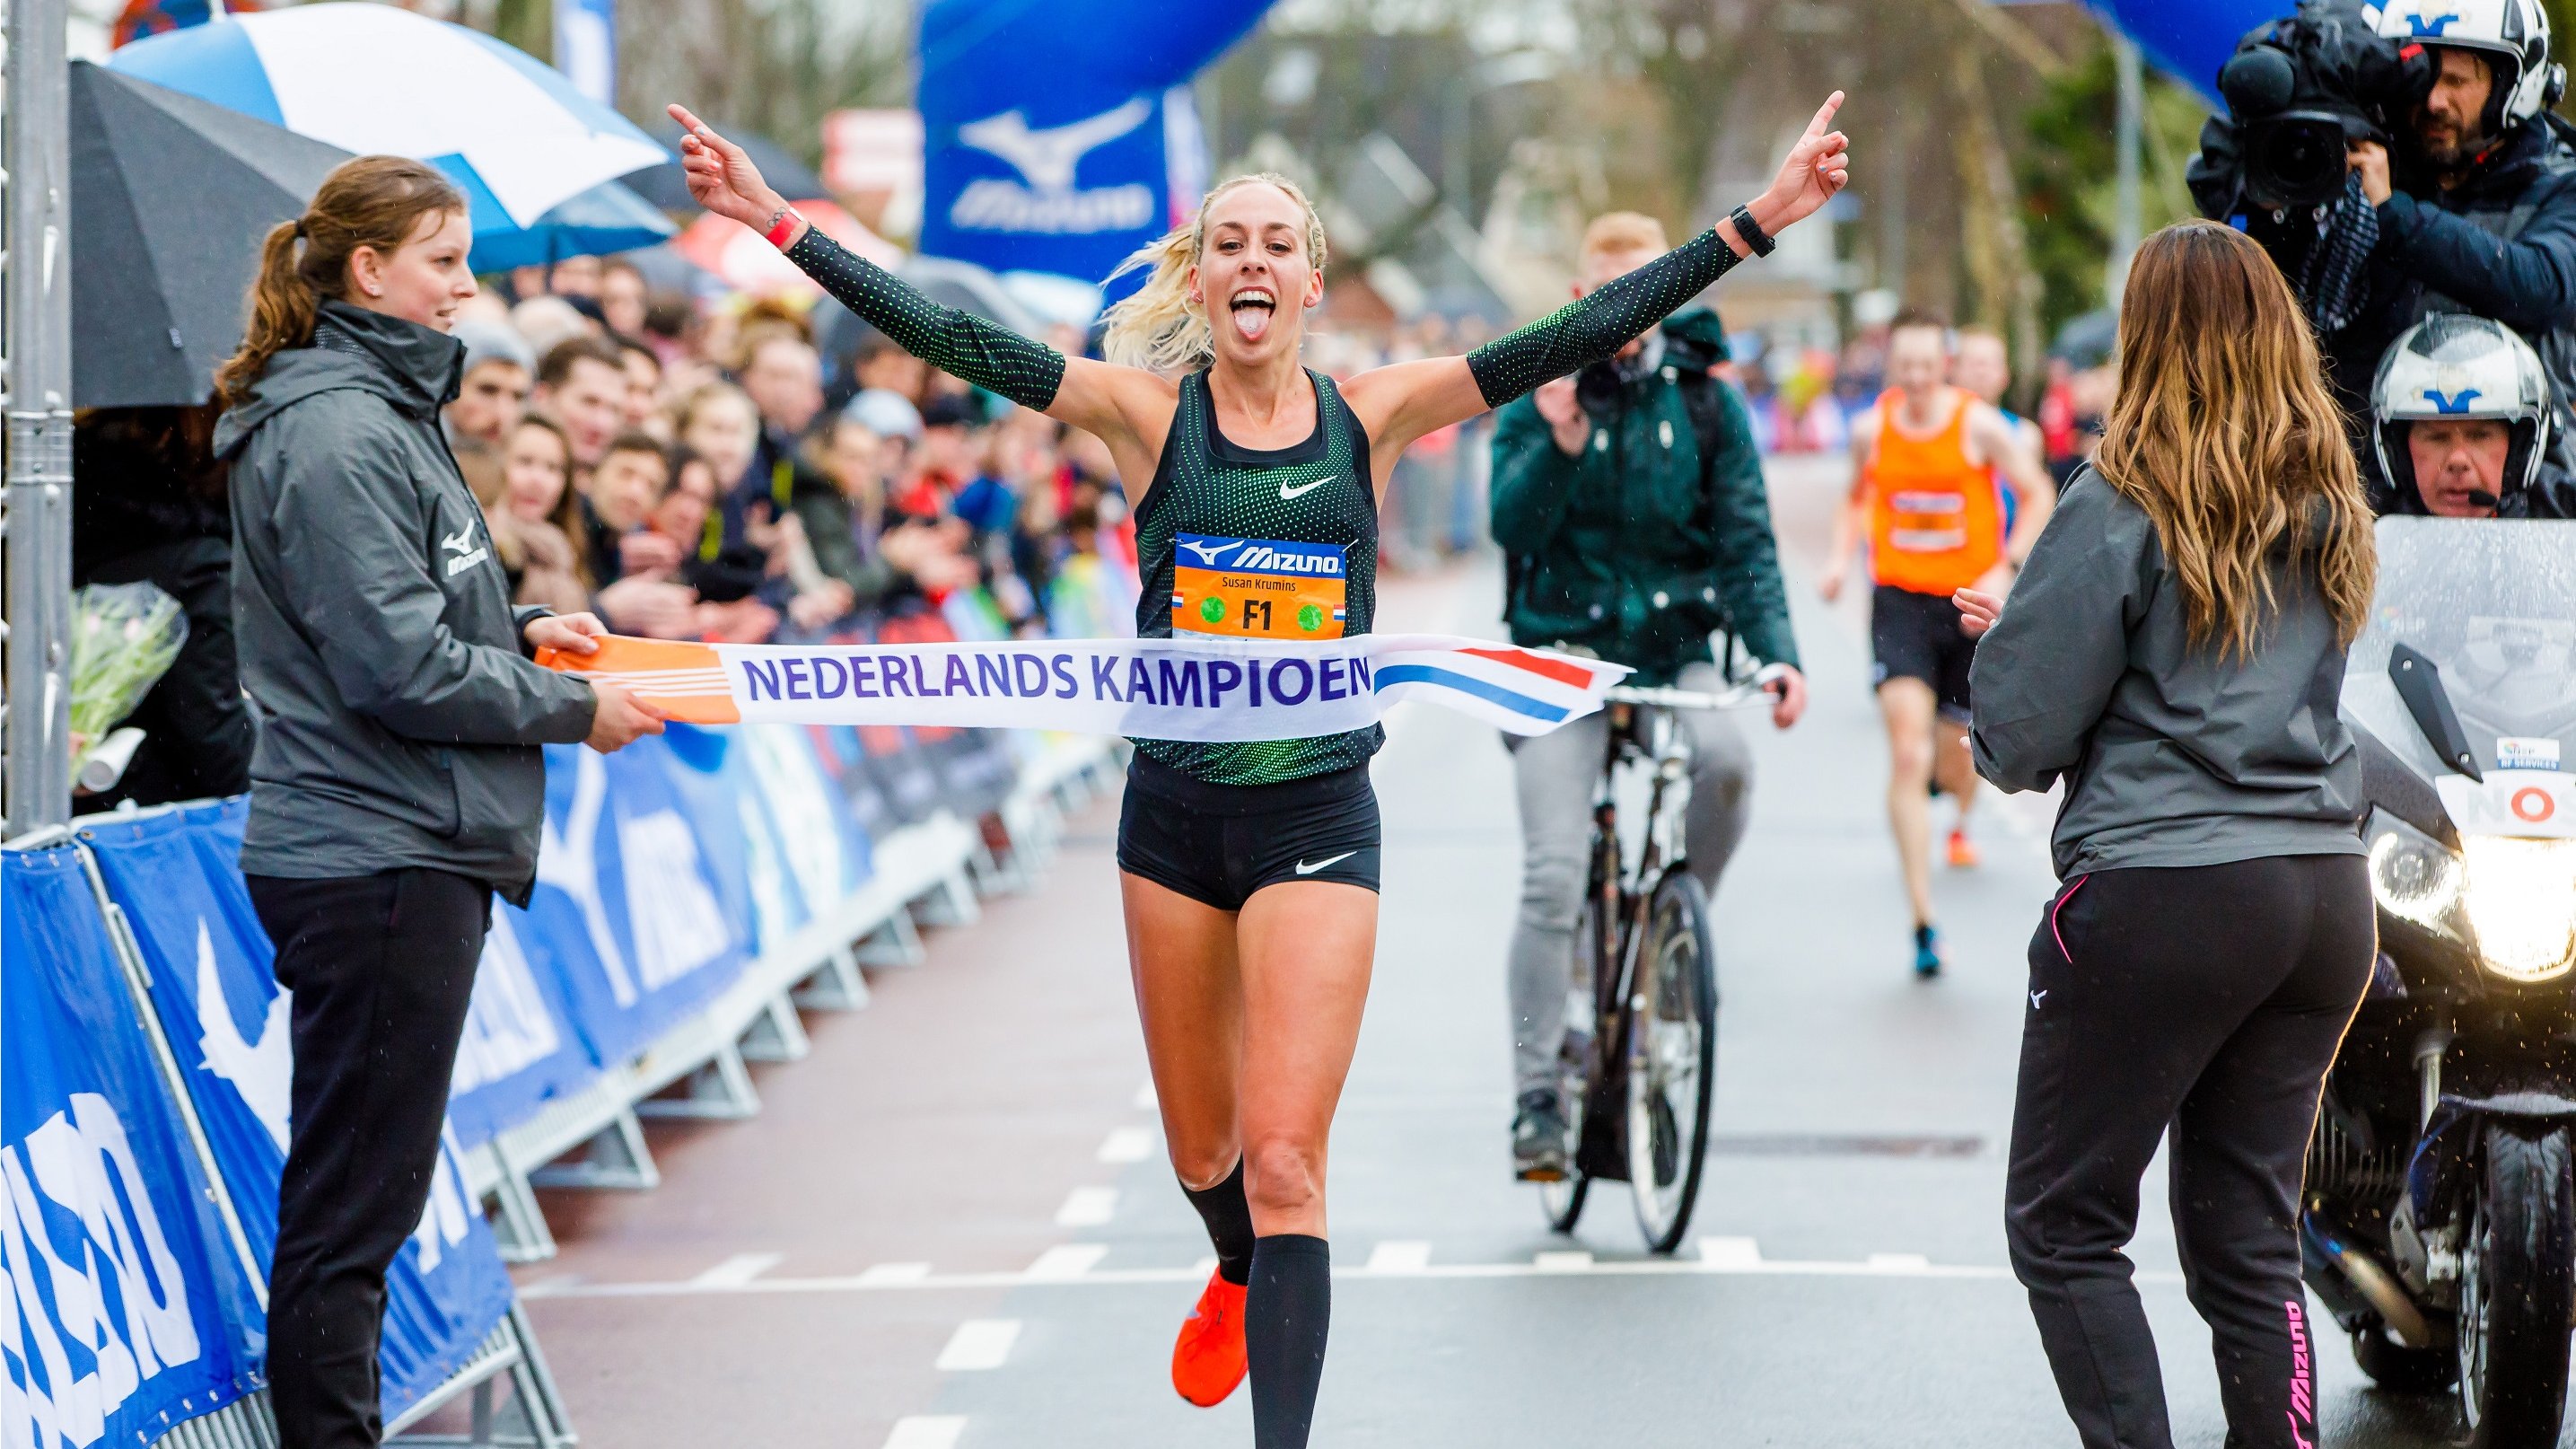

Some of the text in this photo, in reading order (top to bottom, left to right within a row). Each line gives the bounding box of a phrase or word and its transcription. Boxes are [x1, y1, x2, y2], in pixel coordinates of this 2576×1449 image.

[1222, 576, 1296, 592] Susan Krumins
[1242, 599, 1272, 631] F1
[740, 653, 1371, 708] NEDERLANDS KAMPIOEN
